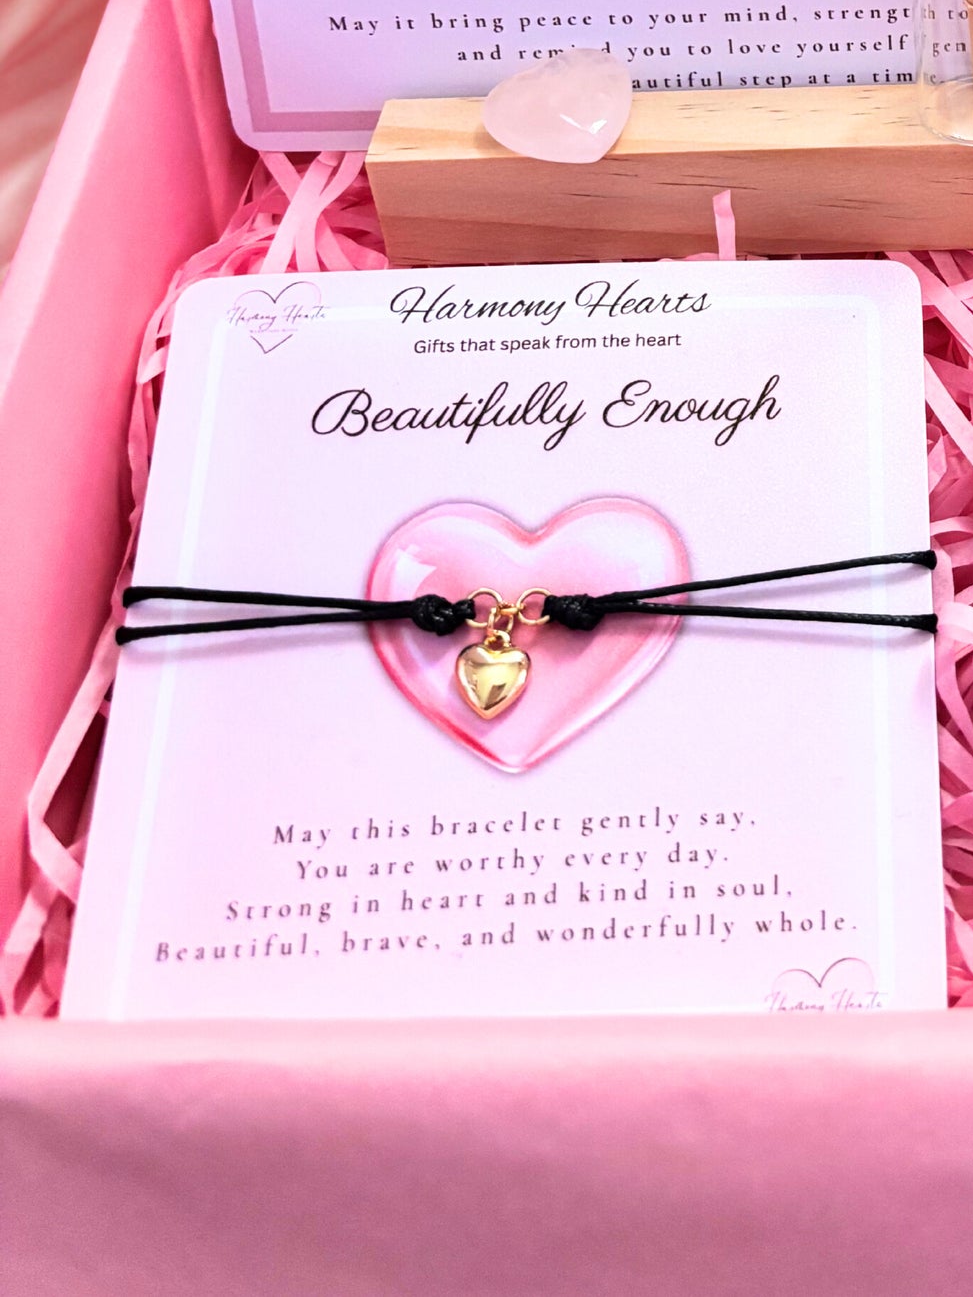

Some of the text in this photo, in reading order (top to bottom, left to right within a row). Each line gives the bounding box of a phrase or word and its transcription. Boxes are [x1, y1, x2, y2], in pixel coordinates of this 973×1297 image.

[328, 16, 379, 36] May
[395, 15, 415, 30] it
[430, 12, 504, 34] bring
[519, 15, 592, 33] peace
[608, 14, 634, 26] to
[648, 12, 708, 30] your
[724, 4, 798, 23] mind,
[457, 43, 502, 61] and
[627, 46, 671, 63] you
[687, 45, 712, 56] to
[727, 38, 781, 55] love
[796, 33, 909, 59] yourself
[631, 71, 723, 90] autiful
[739, 75, 793, 88] step
[807, 73, 831, 87] at
[846, 73, 856, 84] a
[389, 278, 712, 326] Harmony Hearts
[413, 333, 682, 354] Gifts that speak from the heart
[311, 374, 782, 452] Beautifully Enough
[273, 805, 756, 850] May this bracelet gently say,
[296, 841, 728, 881] You are worthy every day.
[225, 873, 792, 924] Strong in heart and kind in soul,
[154, 909, 857, 963] Beautiful, brave, and wonderfully whole.
